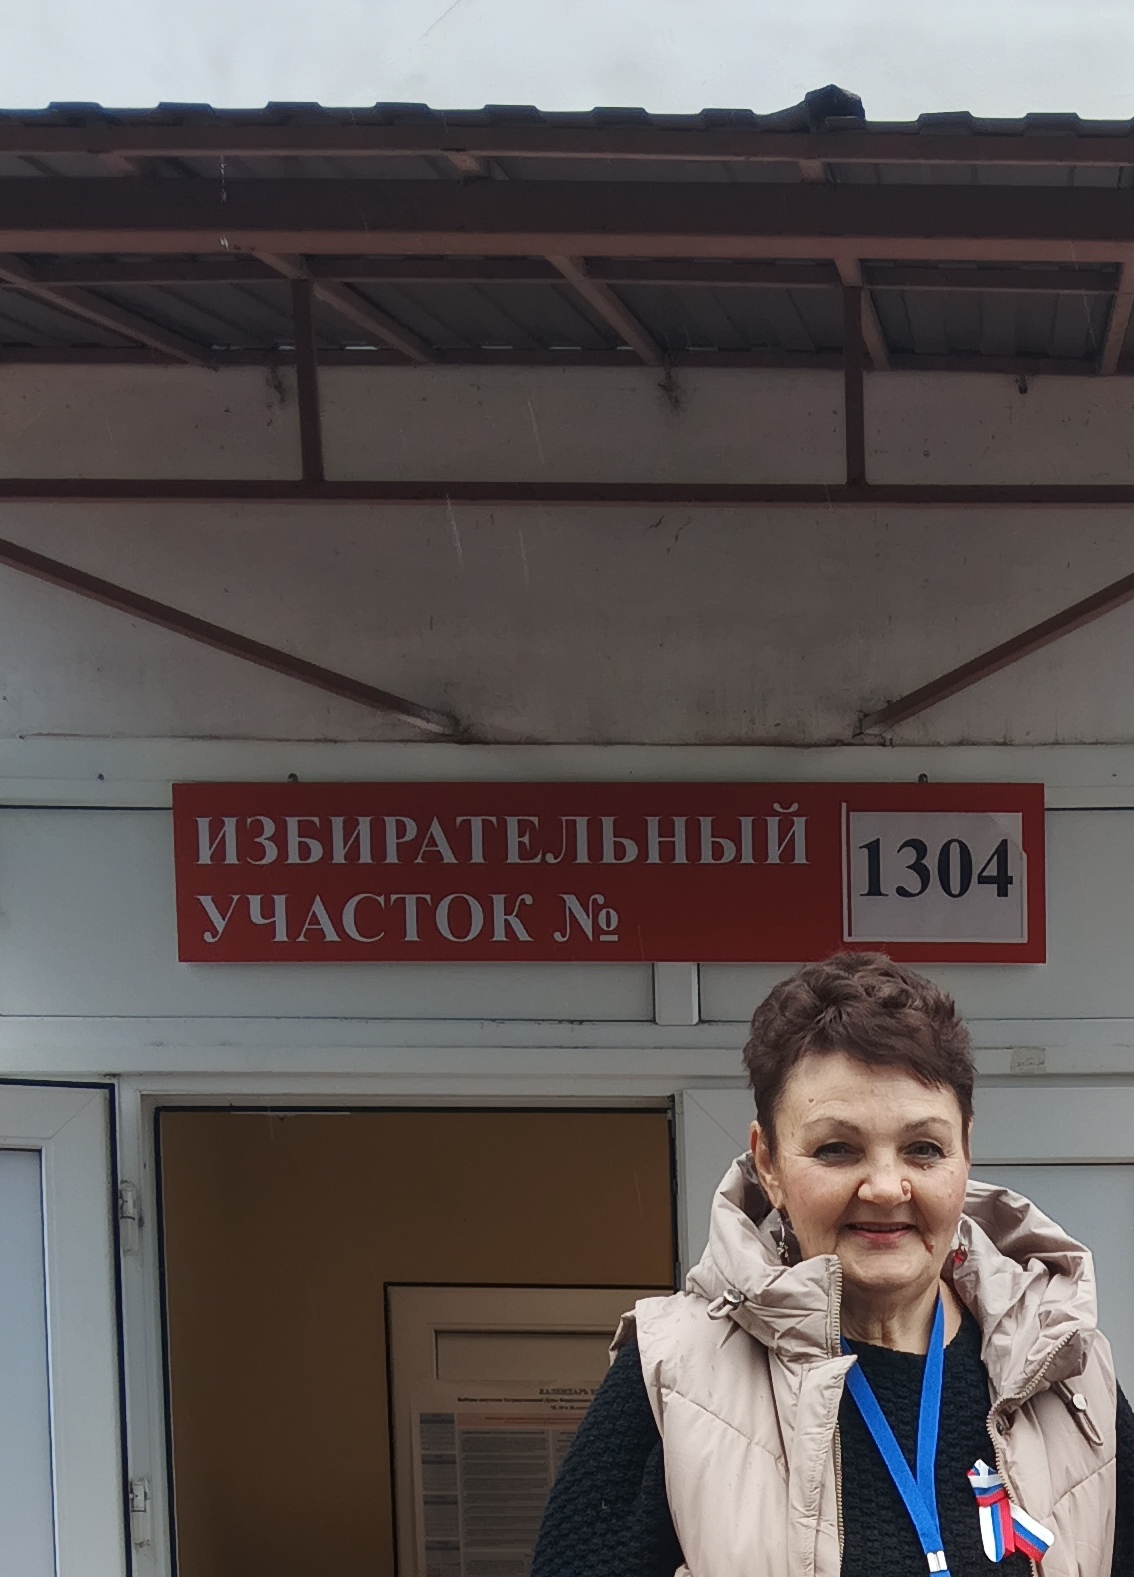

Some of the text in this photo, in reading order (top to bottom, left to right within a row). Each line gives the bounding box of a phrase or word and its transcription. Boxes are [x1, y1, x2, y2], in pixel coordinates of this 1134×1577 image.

[193, 802, 811, 865] ИЗБИРАТЕЛЬНЫЙ
[195, 837, 1014, 943] УЧАСТОК № 1304
